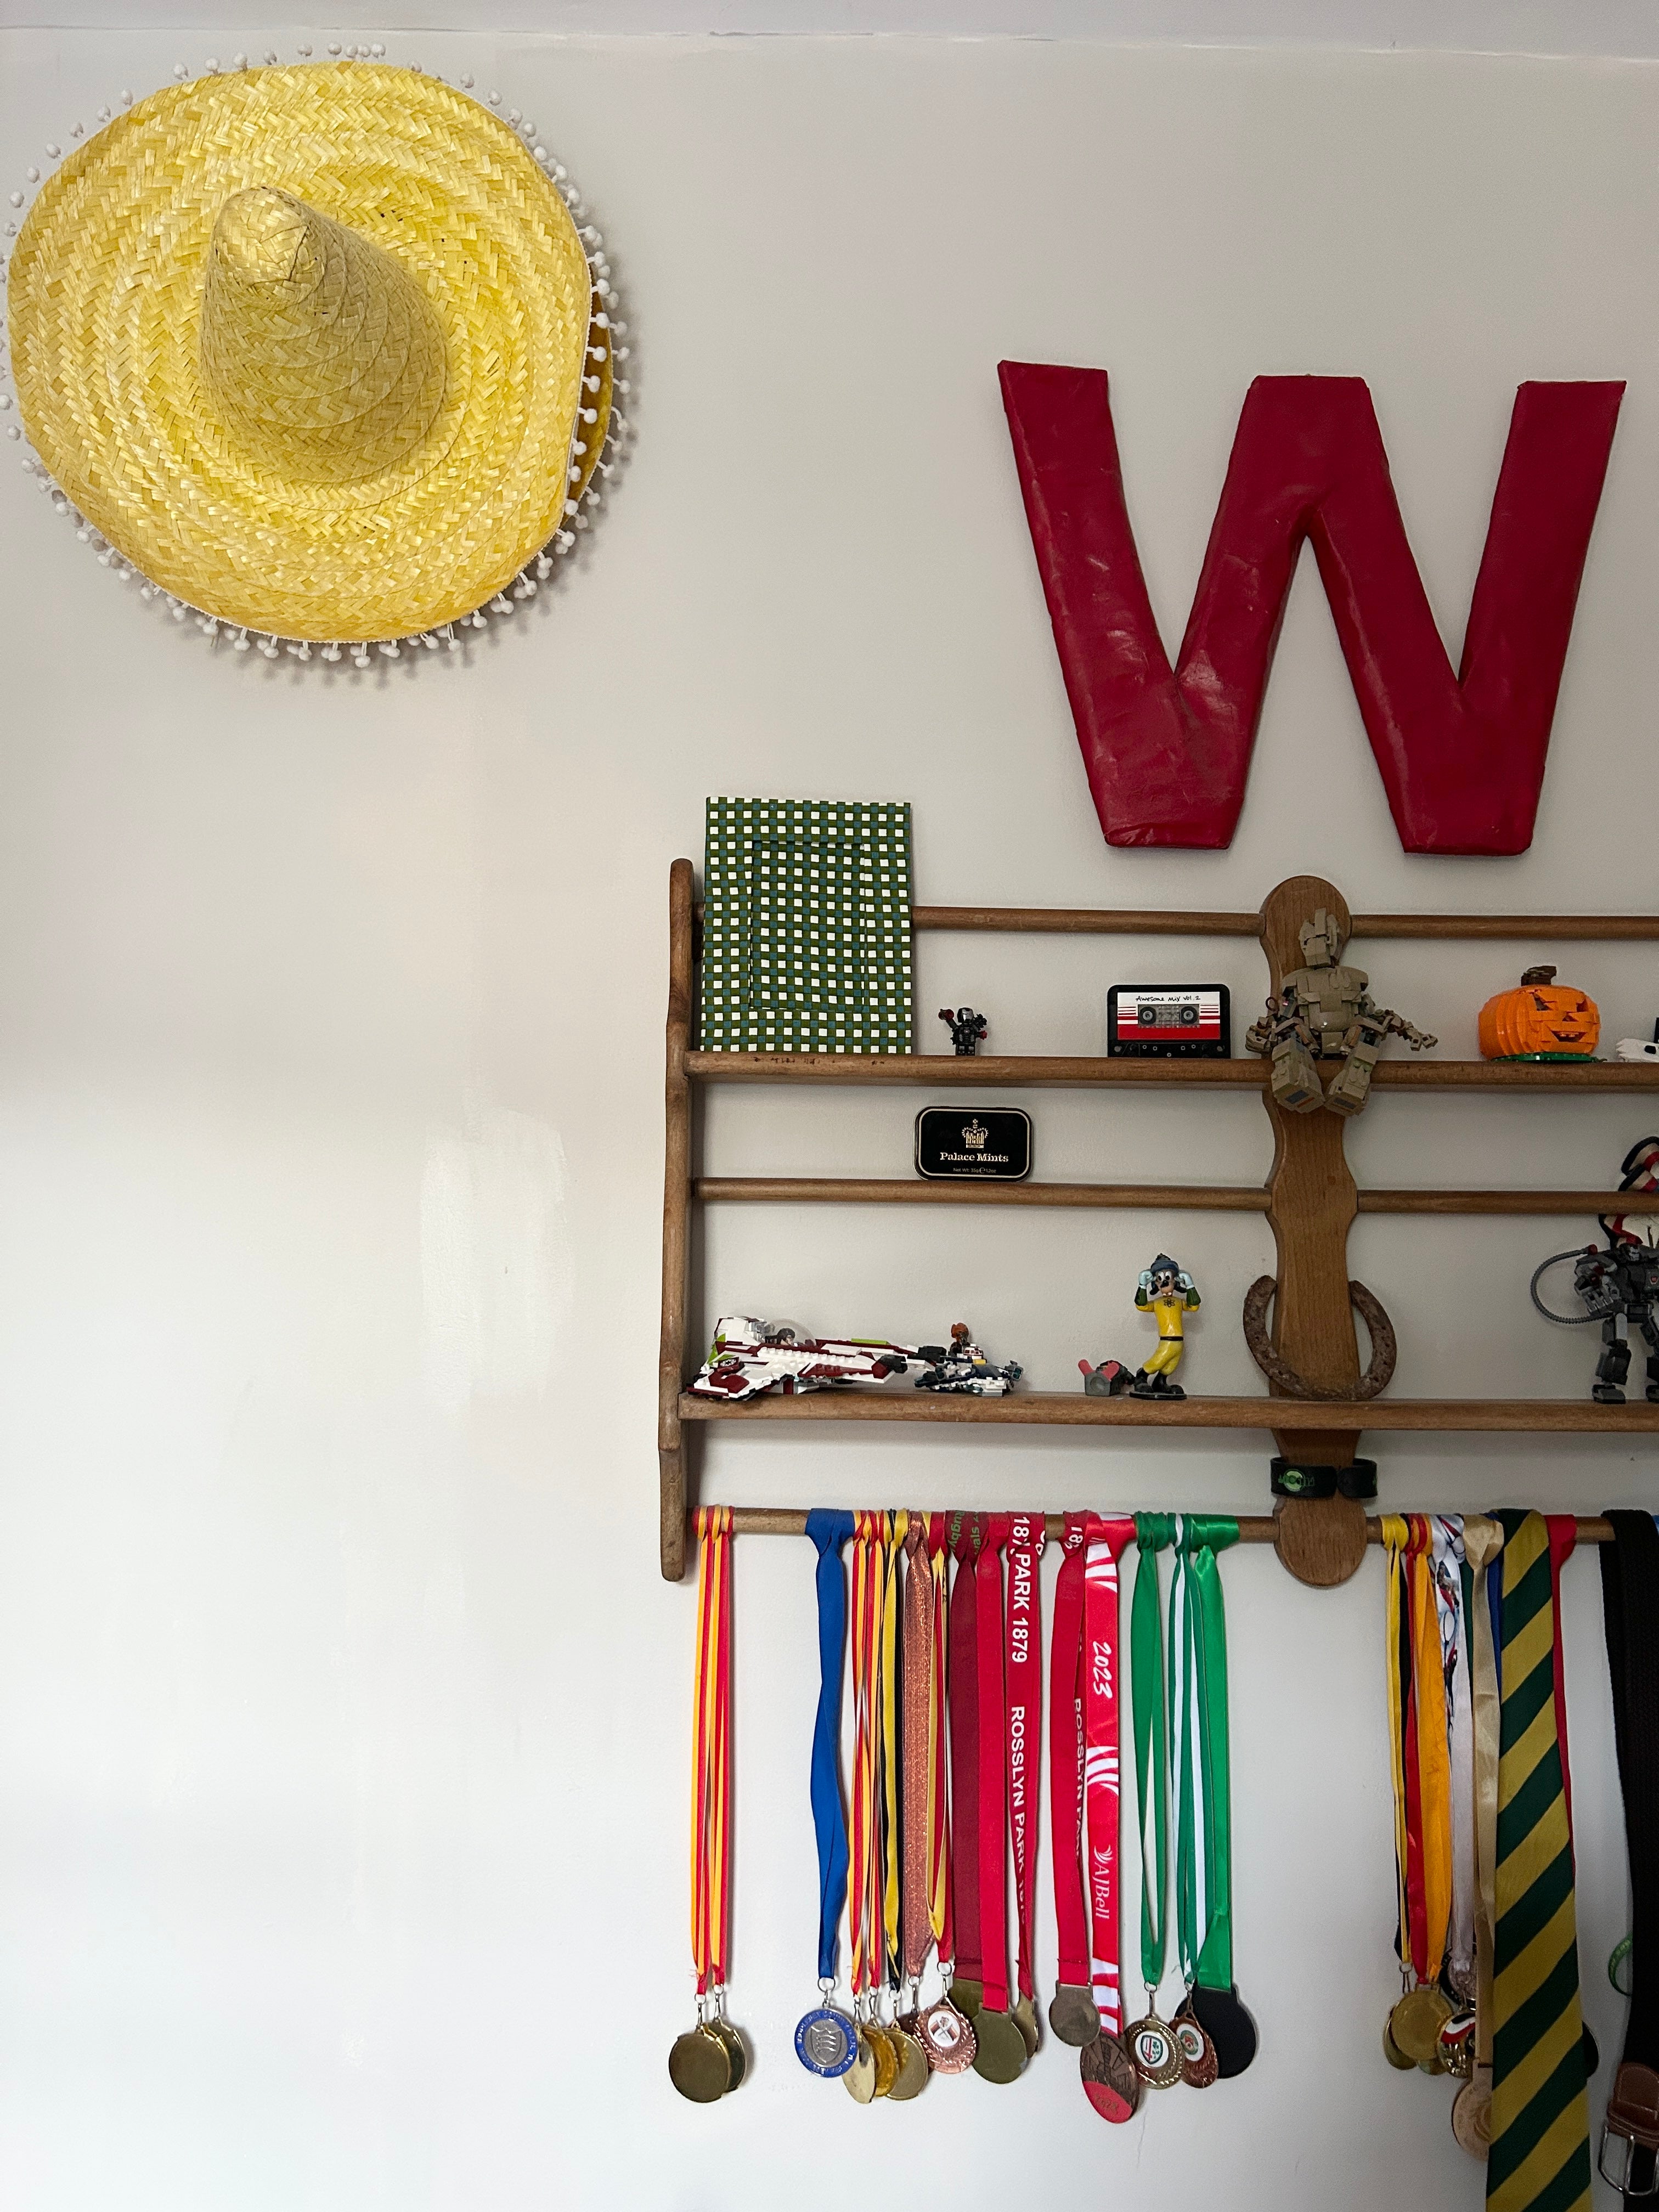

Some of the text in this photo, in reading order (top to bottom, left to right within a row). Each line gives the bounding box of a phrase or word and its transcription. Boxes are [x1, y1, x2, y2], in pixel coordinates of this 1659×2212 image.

[997, 360, 1627, 855] W
[940, 1152, 1009, 1162] Palace Mints
[1012, 1553, 1031, 1663] PARK 1879
[1092, 1641, 1113, 1699] 2023
[1011, 1706, 1025, 1807] ROSSLYN
[1074, 1698, 1083, 1800] ROSSLYN
[1015, 1814, 1025, 1874] PARK
